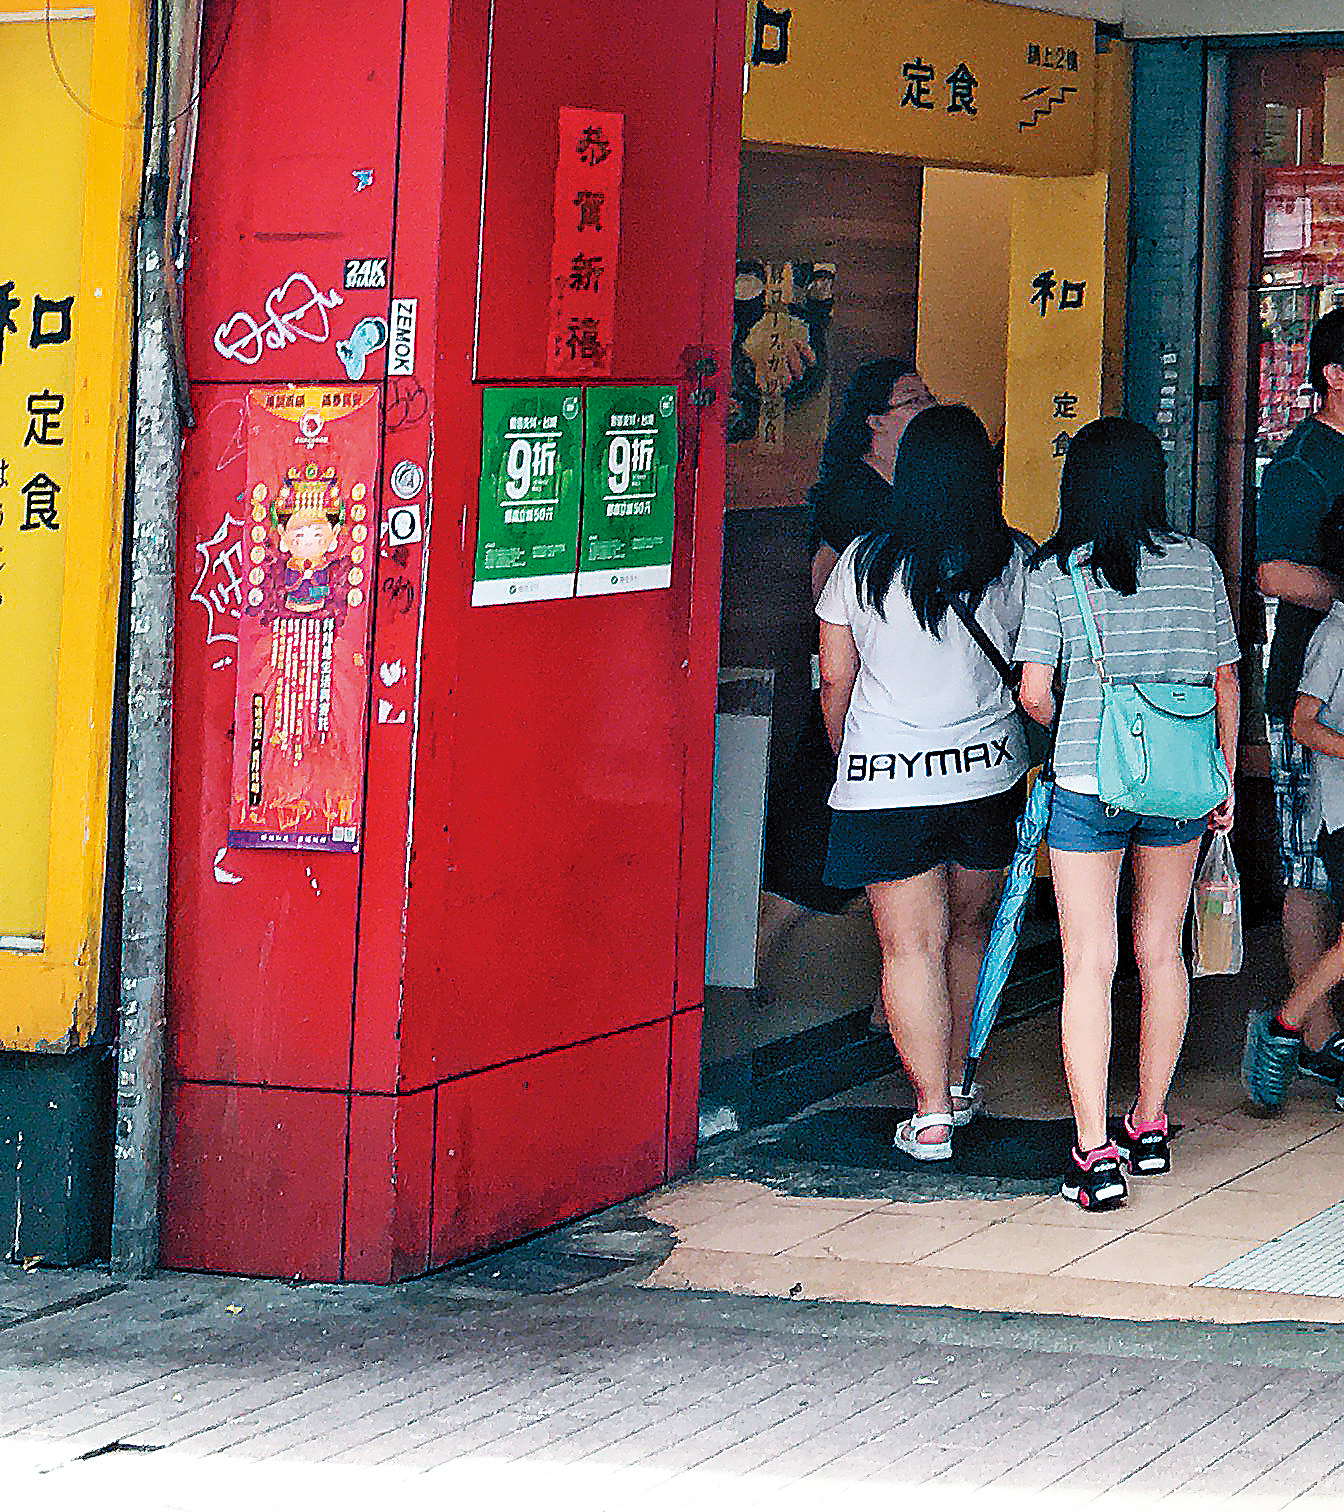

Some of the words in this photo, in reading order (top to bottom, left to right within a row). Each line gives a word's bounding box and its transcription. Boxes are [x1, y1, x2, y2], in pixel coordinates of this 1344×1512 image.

[900, 57, 980, 116] 定食
[1030, 269, 1087, 317] 和
[394, 303, 414, 372] ZEMOK
[19, 389, 66, 531] 定食
[505, 438, 557, 500] 9折
[607, 436, 655, 494] 9折
[847, 735, 1014, 782] BAYMAX
